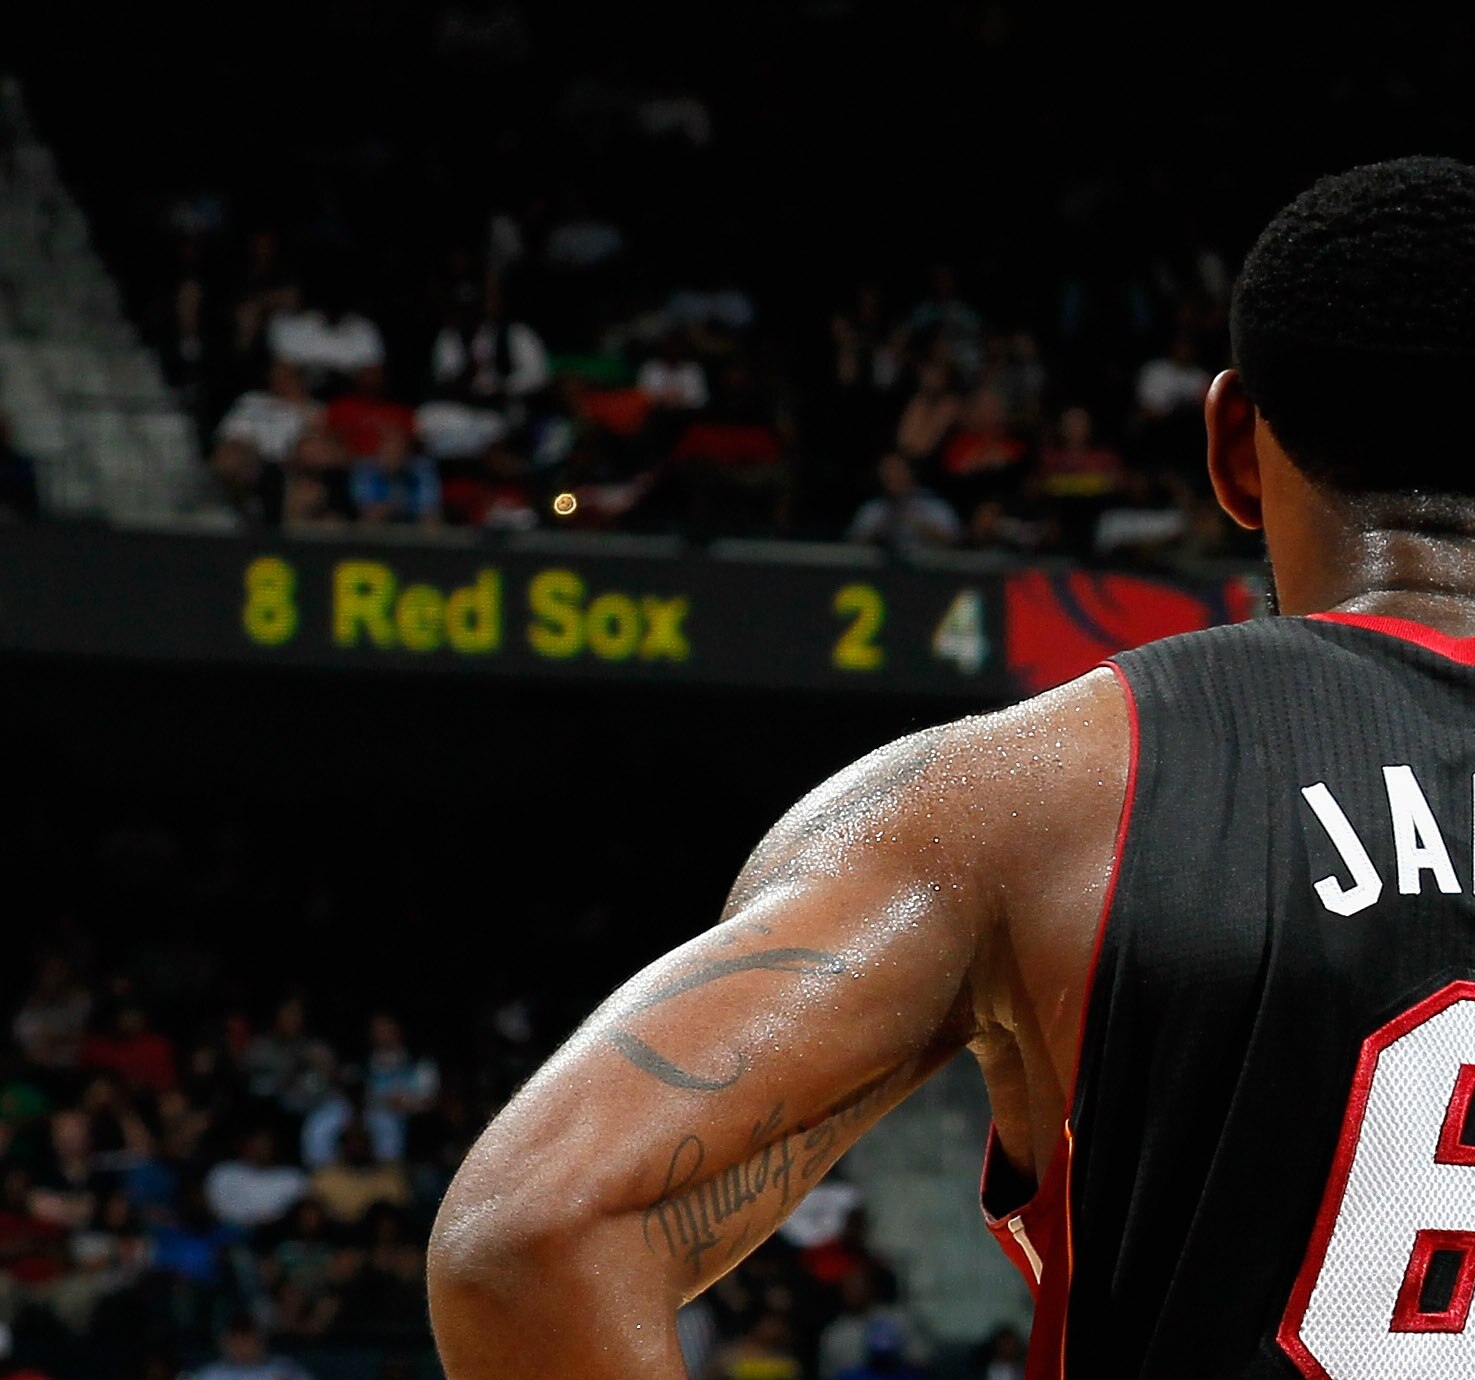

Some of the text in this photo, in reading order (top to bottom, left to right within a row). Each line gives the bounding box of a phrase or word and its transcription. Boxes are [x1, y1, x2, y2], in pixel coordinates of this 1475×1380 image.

[243, 557, 985, 674] 8 Red Sox 2 4
